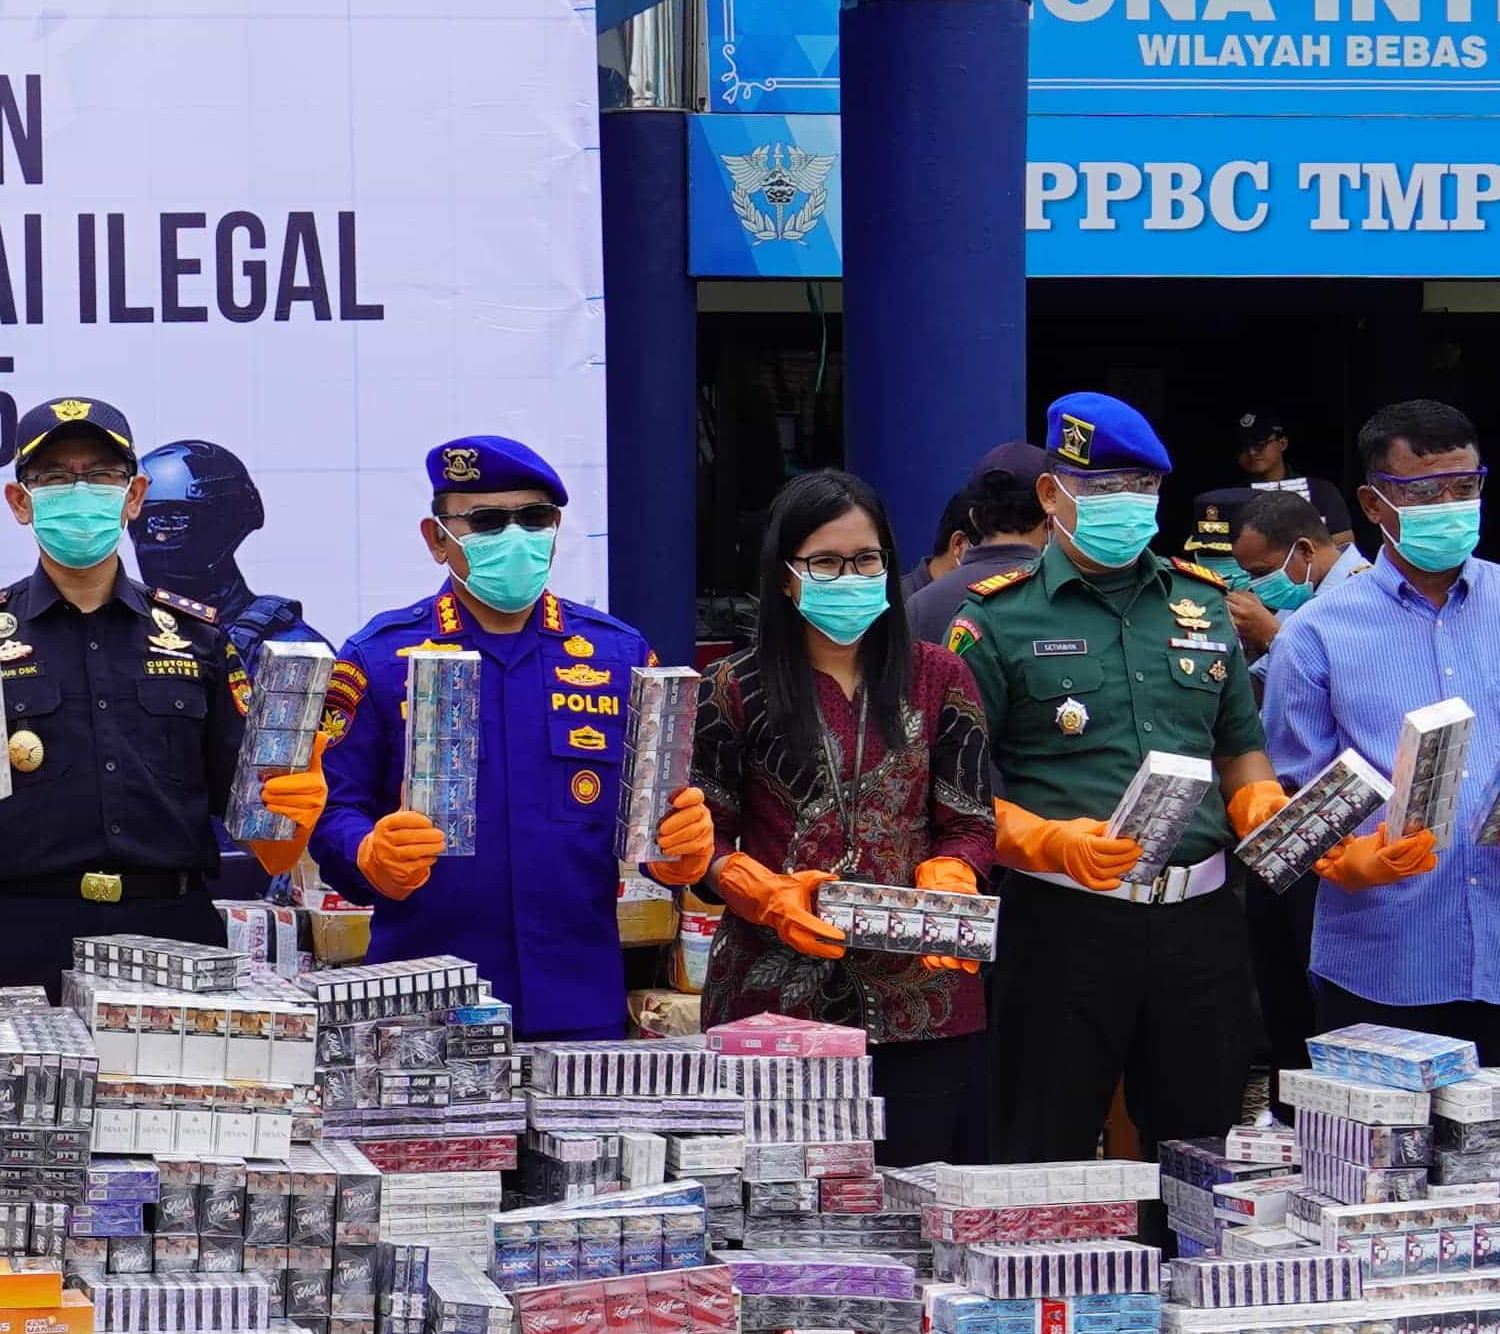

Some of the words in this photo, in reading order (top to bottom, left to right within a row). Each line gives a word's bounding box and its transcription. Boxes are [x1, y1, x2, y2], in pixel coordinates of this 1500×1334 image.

[1138, 34, 1331, 67] WILAYAH
[1346, 35, 1488, 69] BEBAS
[1025, 159, 1270, 235] PPBC
[78, 211, 384, 323] ILEGAL
[146, 660, 199, 669] CUSTOMS
[147, 667, 200, 677] EXCISE
[551, 692, 620, 716] POLRI
[587, 1255, 616, 1266] LINK
[629, 1252, 657, 1264] LINK
[671, 1251, 698, 1262] LINK
[502, 1260, 531, 1270] LINK
[545, 1259, 573, 1269] LINK
